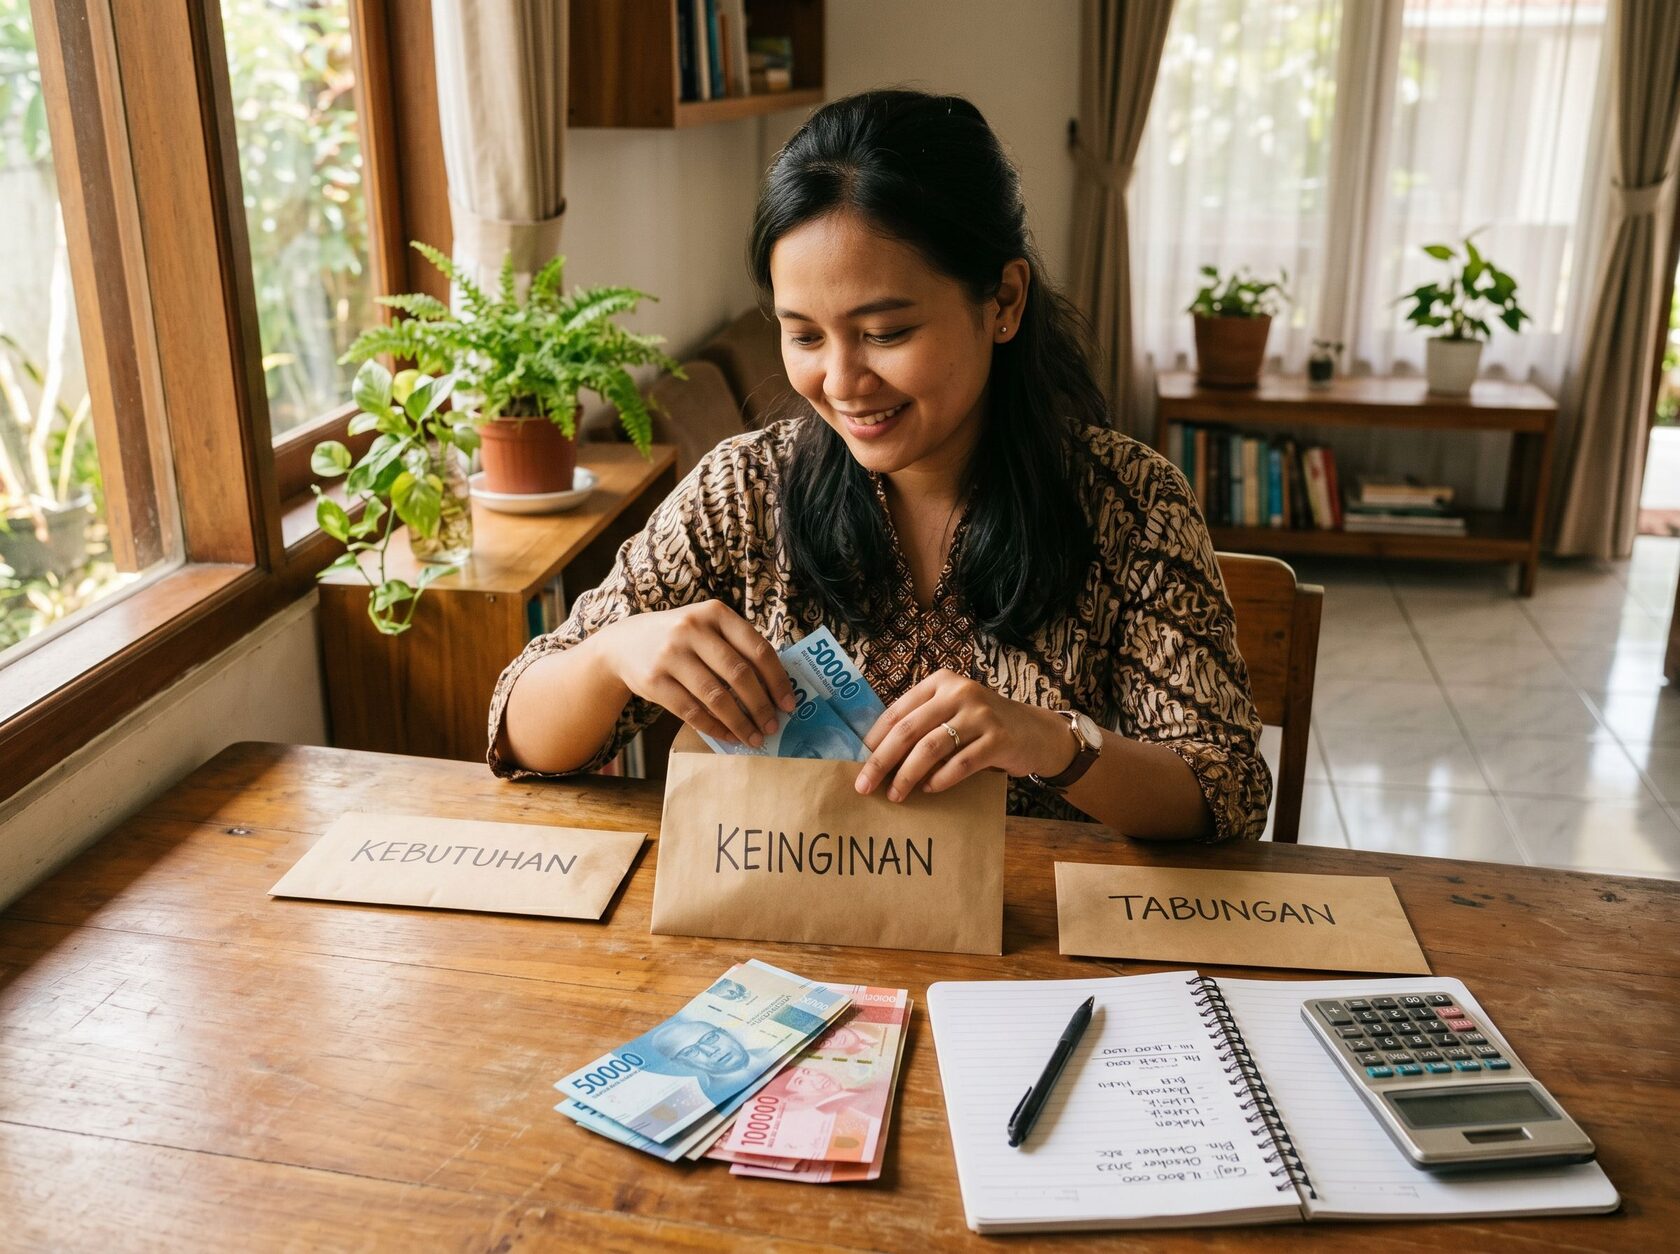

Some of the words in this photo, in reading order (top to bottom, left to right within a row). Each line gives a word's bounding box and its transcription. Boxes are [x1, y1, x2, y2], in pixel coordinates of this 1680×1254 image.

[807, 638, 860, 699] 50000
[350, 839, 578, 875] KEBUTUHAN
[715, 823, 933, 876] KEINGINAN
[1108, 895, 1336, 925] TABUNGAN
[571, 1052, 645, 1095] 50000
[741, 1095, 780, 1147] 100000
